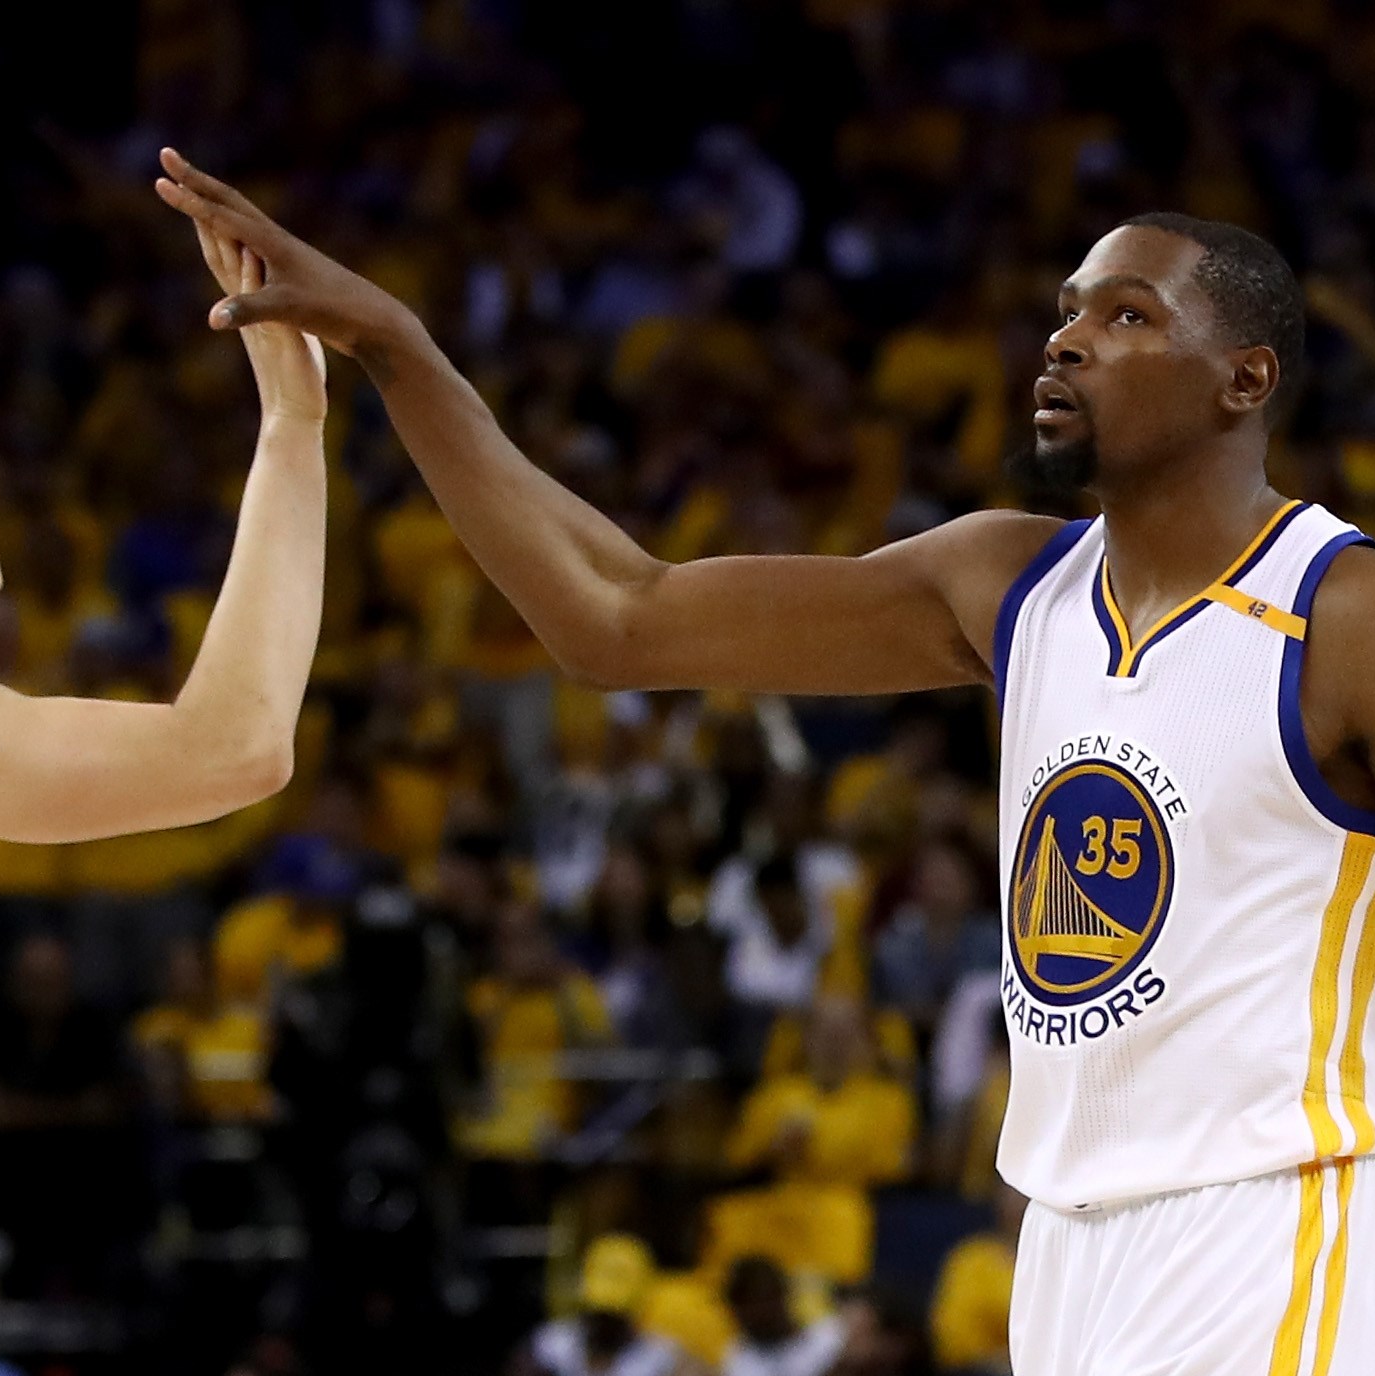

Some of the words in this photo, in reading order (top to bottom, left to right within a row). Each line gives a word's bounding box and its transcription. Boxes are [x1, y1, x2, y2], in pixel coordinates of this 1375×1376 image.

[1248, 600, 1268, 618] 42
[1021, 735, 1111, 808] GOLDEN
[1117, 743, 1187, 820] STATE
[1075, 815, 1143, 880] 35
[1002, 960, 1166, 1046] WARRIORS
